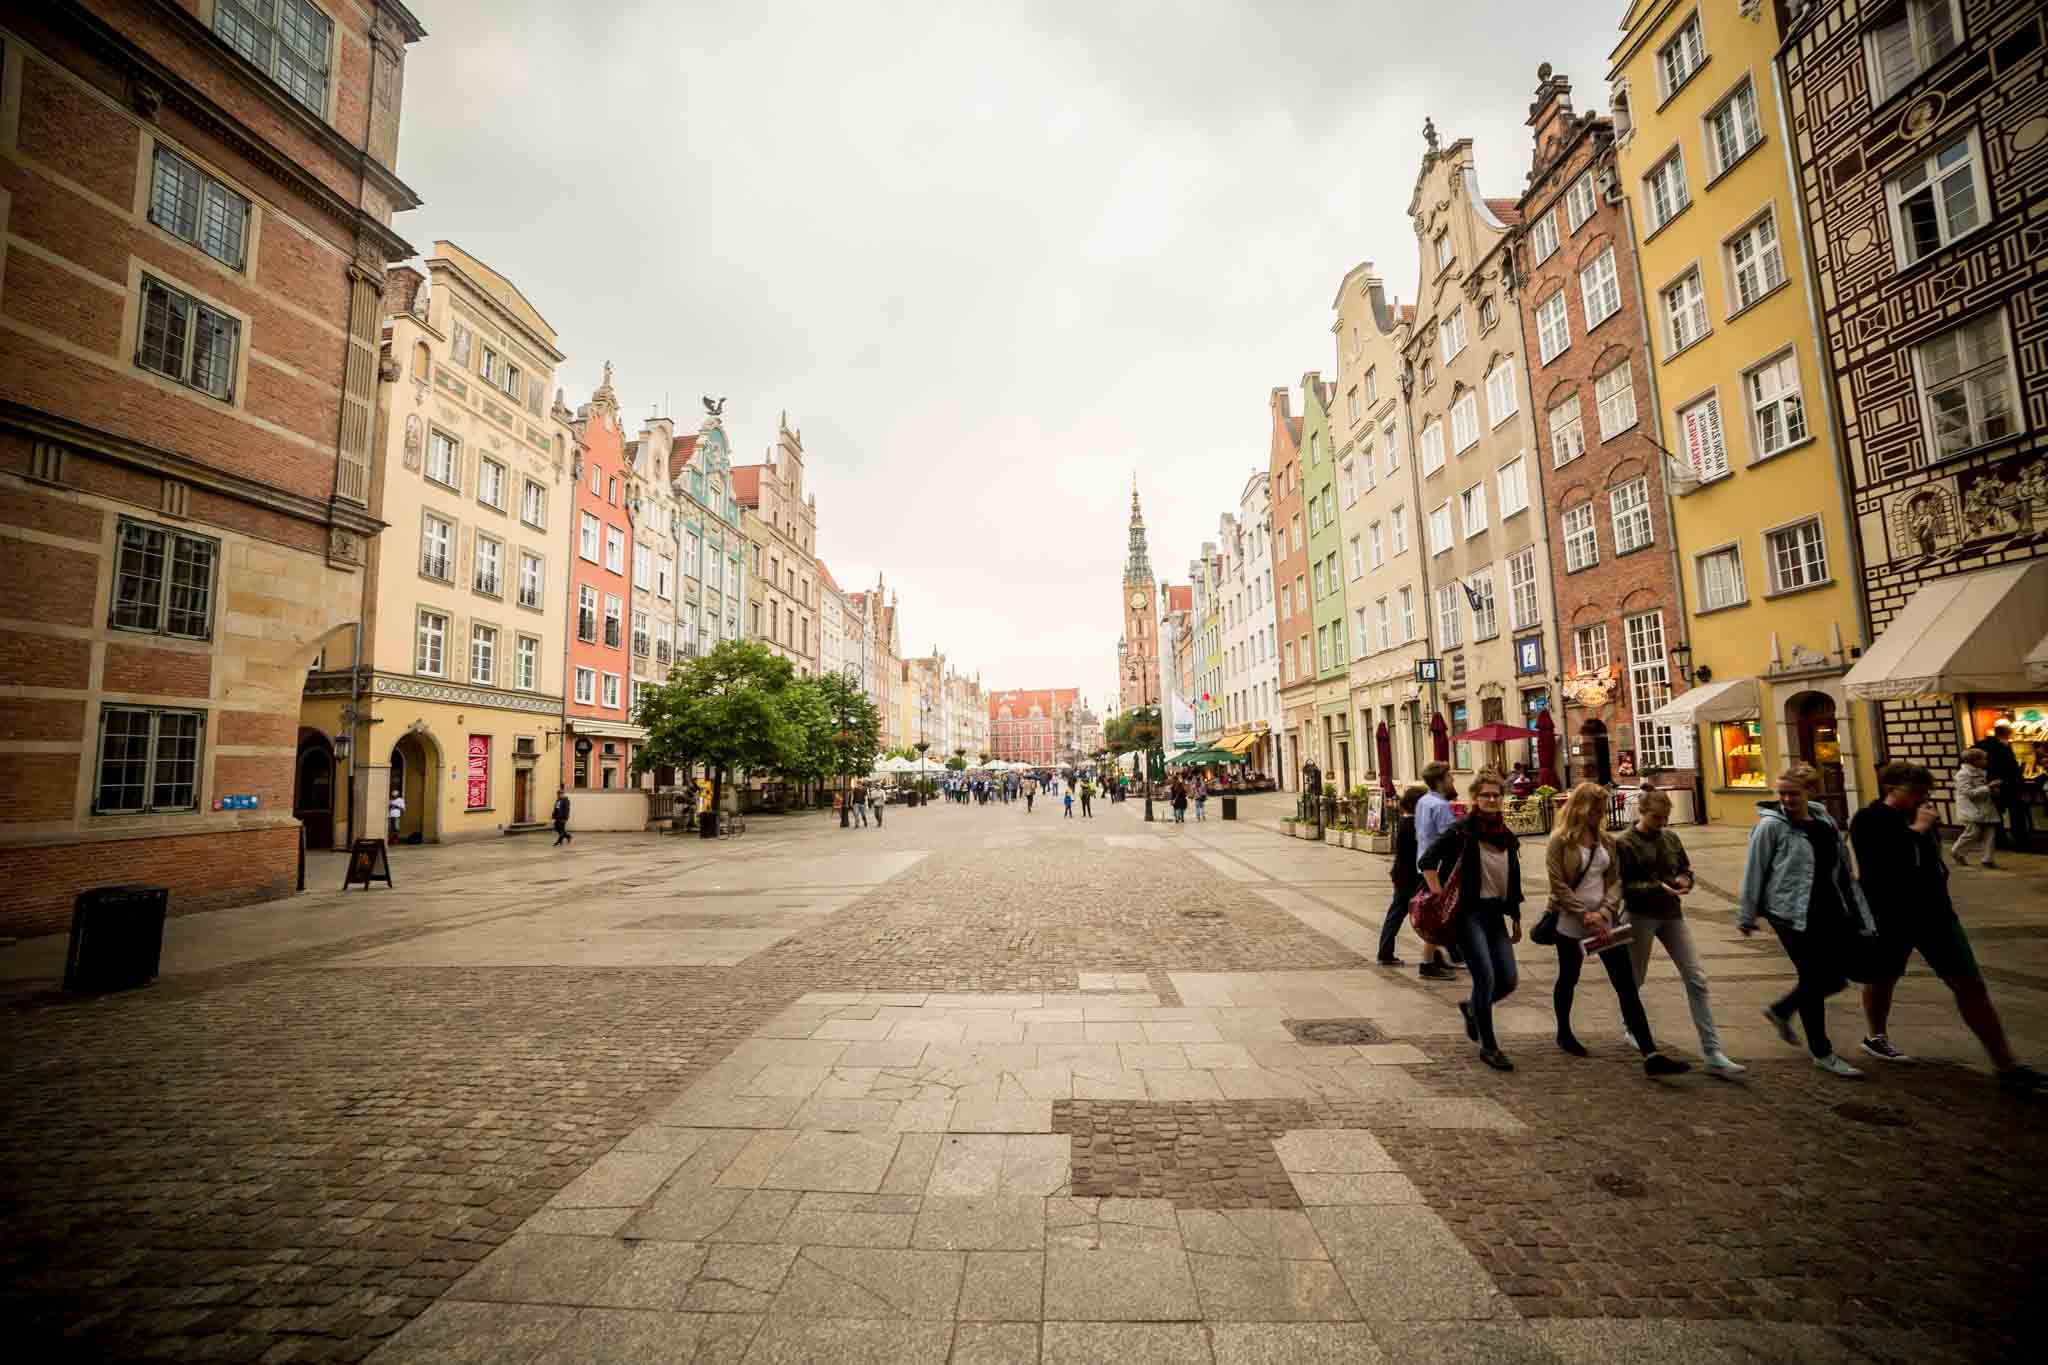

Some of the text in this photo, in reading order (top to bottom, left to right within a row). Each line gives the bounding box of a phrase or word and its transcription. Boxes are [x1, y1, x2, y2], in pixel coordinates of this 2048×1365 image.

[1698, 412, 1712, 470] PO REMONCIE
[1707, 400, 1725, 470] WYSOKI STANDARD
